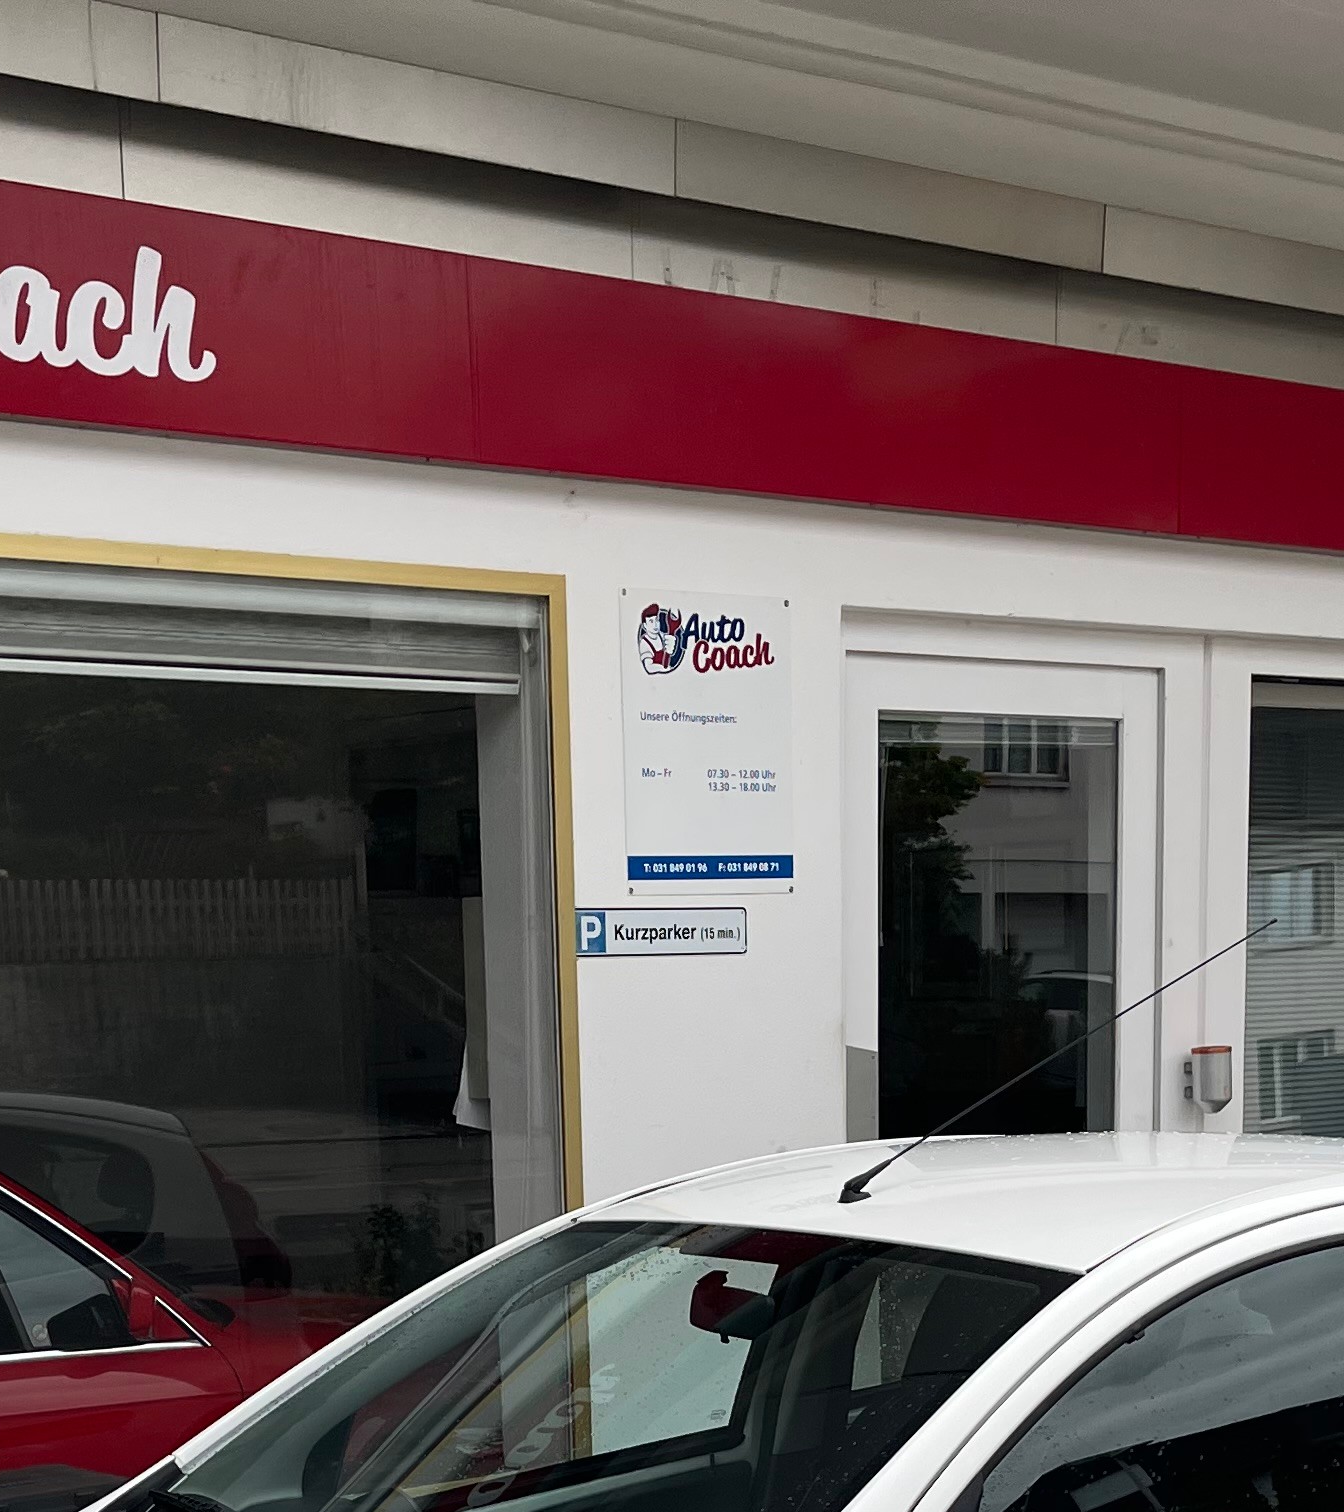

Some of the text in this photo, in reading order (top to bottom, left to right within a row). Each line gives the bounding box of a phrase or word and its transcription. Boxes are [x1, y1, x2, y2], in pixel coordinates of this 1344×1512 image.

[681, 612, 745, 649] Auto
[693, 633, 775, 673] Coach
[639, 709, 737, 725] Unsere Öffnungszeiten:
[641, 767, 656, 778] Mo
[663, 767, 672, 778] Fr
[707, 769, 730, 778] 07.30
[738, 769, 760, 779] 12.00
[761, 769, 776, 779] Uhr
[708, 782, 730, 792] 13.30
[739, 782, 760, 792] 18.00
[762, 782, 776, 792] Uhr
[653, 863, 668, 873] 031
[669, 862, 685, 873] 849
[727, 862, 742, 872] 031
[743, 862, 758, 872] 849
[580, 915, 741, 951] P Kurzparker (15 min.)
